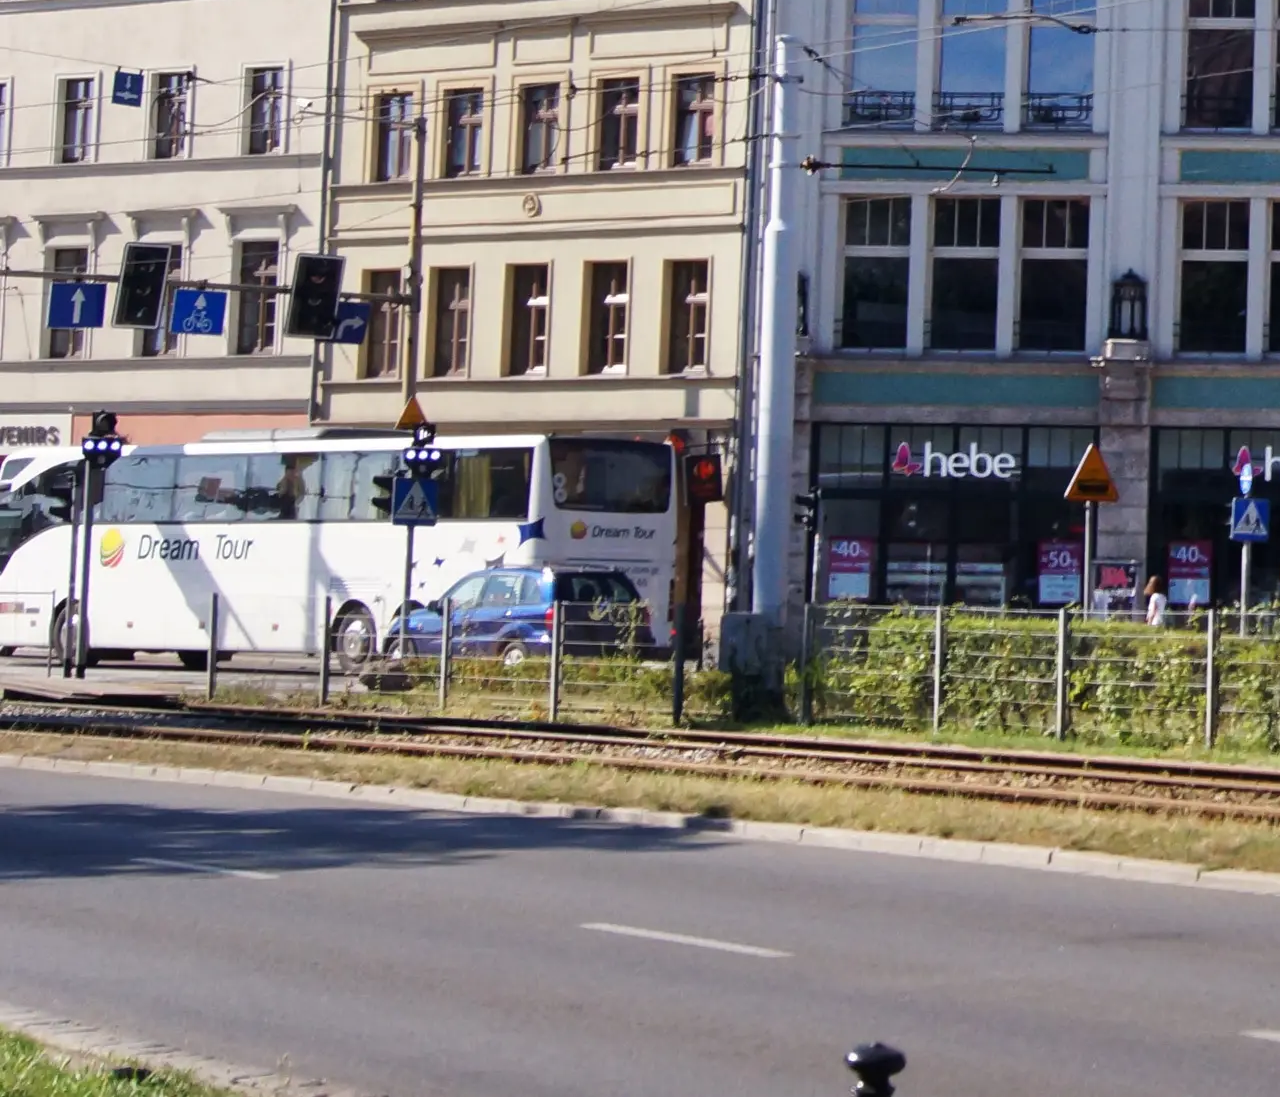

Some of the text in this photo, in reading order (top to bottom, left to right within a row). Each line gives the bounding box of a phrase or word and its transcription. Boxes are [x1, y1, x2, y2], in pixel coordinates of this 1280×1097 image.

[922, 441, 1016, 478] hebe
[591, 524, 656, 539] Dream Tour
[137, 534, 254, 560] Dream Tour
